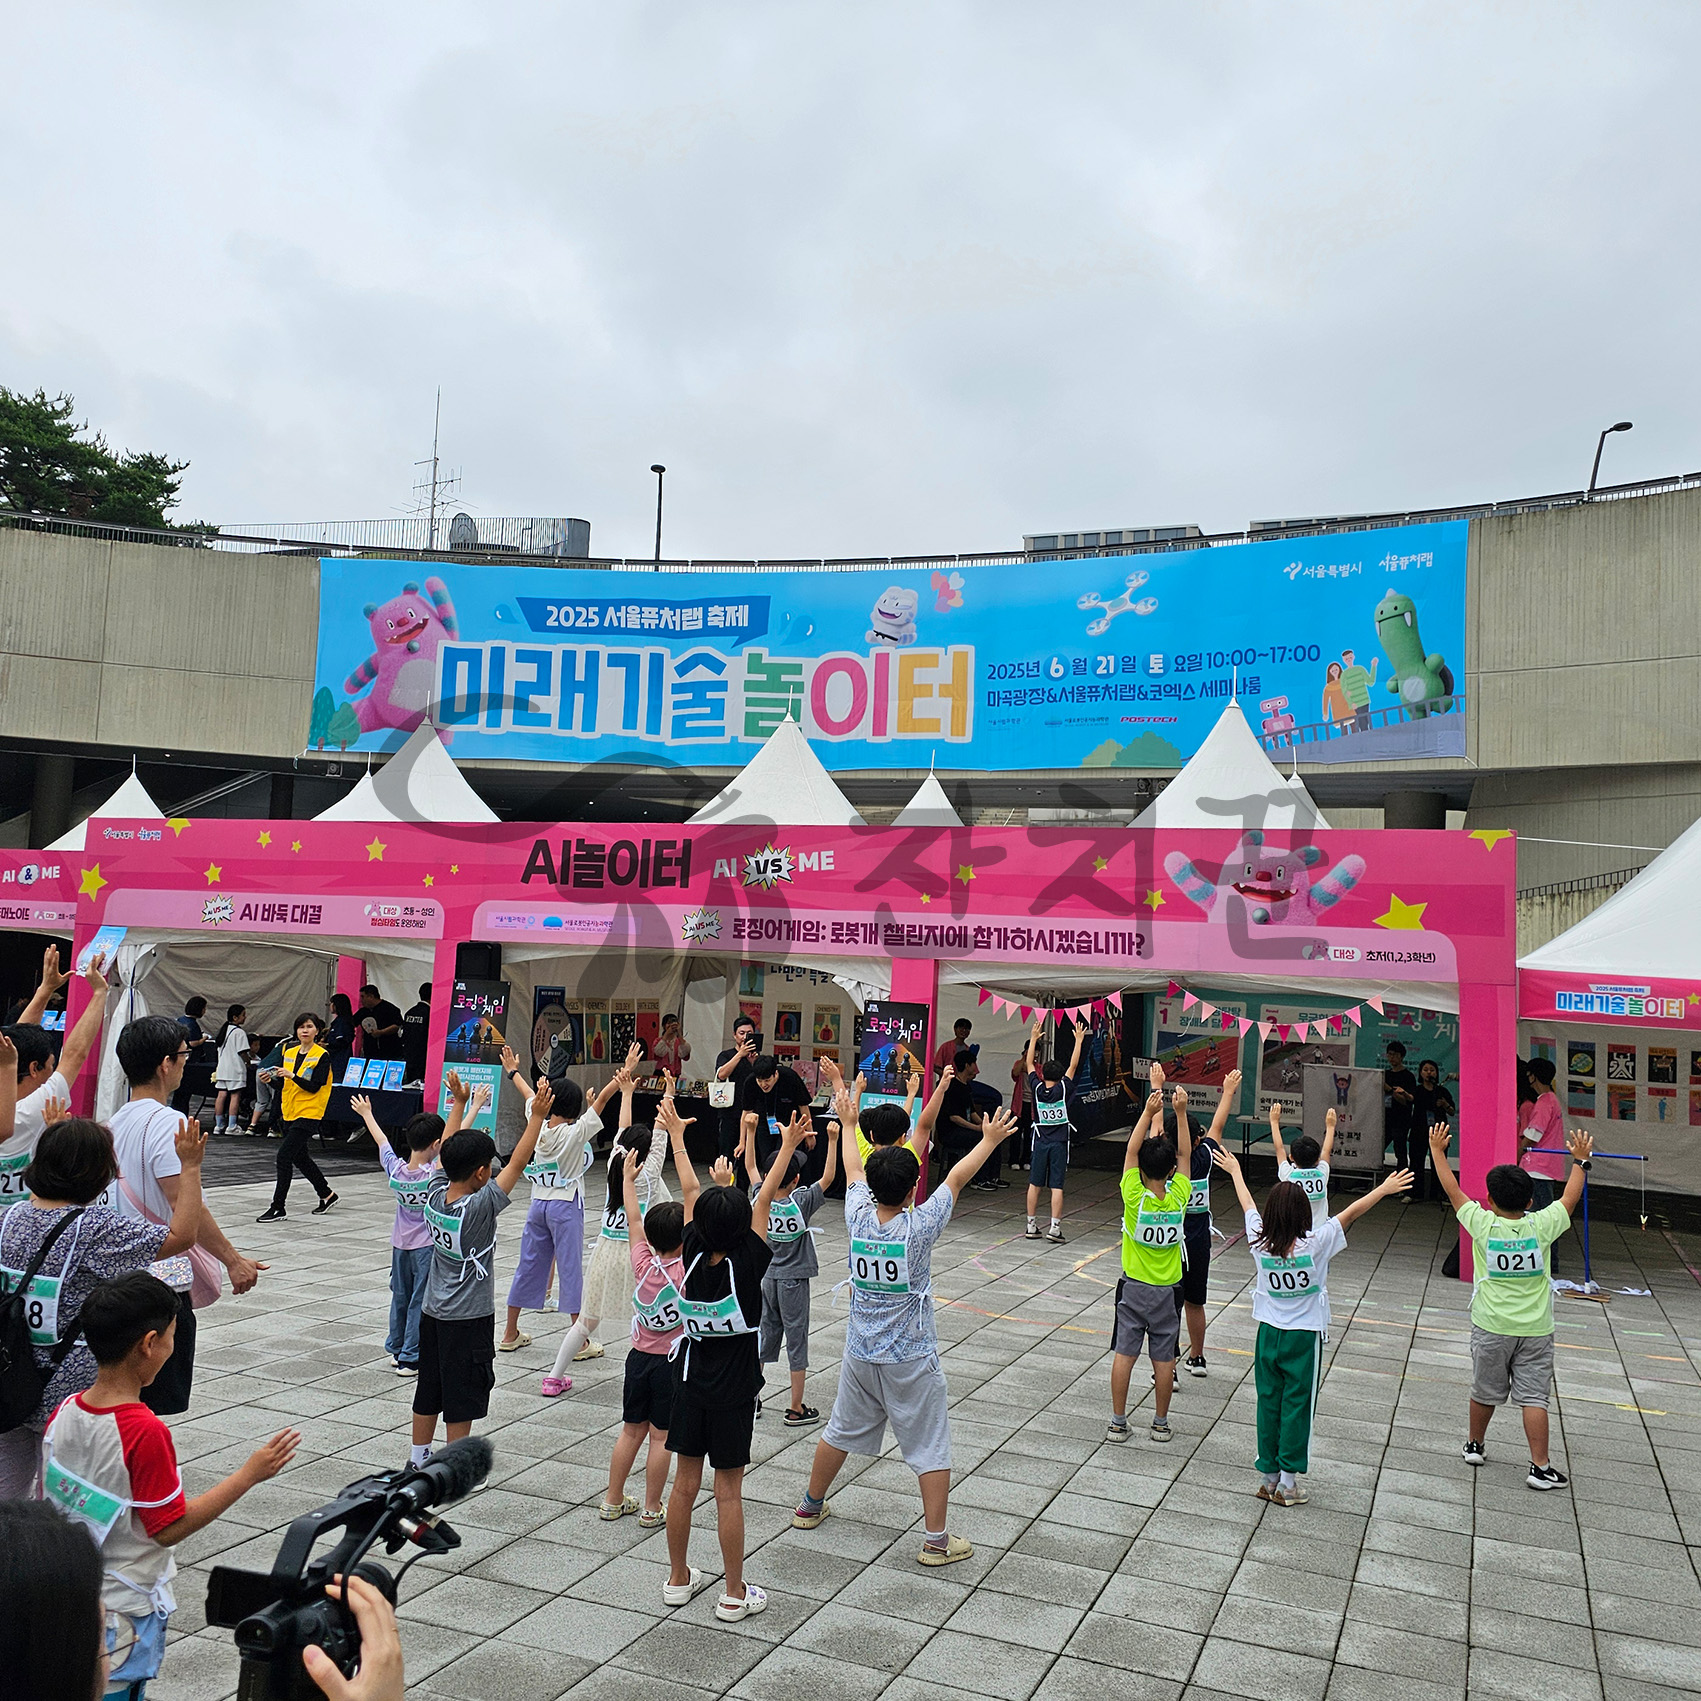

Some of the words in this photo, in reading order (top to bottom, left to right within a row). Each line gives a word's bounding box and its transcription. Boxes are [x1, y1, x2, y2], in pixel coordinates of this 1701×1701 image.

[1302, 561, 1362, 579] 서울특별시
[1379, 551, 1433, 572] 서울퓨처랩
[546, 606, 600, 627] 2025
[603, 605, 703, 630] 서울퓨처랩
[708, 605, 749, 628] 축제
[987, 661, 1040, 680] 2025년
[1050, 657, 1064, 678] 6
[1072, 657, 1088, 676] 월
[1096, 655, 1115, 675] 21
[1121, 656, 1136, 674] 일
[1149, 654, 1164, 674] 토
[1174, 653, 1202, 672] 요일
[1206, 644, 1321, 669] 10:00~17:00
[1199, 676, 1261, 698] 세미나룸
[520, 838, 692, 889] AI놀이터
[713, 858, 737, 878] AI
[754, 857, 782, 875] VS
[798, 850, 835, 872] ME
[2, 870, 16, 883] AI
[25, 868, 32, 880] &
[41, 866, 60, 879] ME
[239, 903, 259, 921] AI
[261, 903, 288, 923] 바둑
[290, 904, 322, 924] 대결
[383, 907, 398, 916] 대상
[732, 918, 826, 942] 로징어게임:
[830, 922, 879, 944] 로봇개
[883, 924, 968, 949] 챌린지에
[973, 926, 1146, 957] 참가하시겠습니까?
[1333, 949, 1355, 959] 대상
[1366, 950, 1436, 963] 초저(1,2,3학년)
[1159, 1008, 1168, 1025] 1
[1041, 1110, 1064, 1120] 033
[1143, 1226, 1178, 1245] 002
[856, 1258, 899, 1282] 019
[1497, 1253, 1536, 1270] 021
[1269, 1271, 1310, 1290] 003
